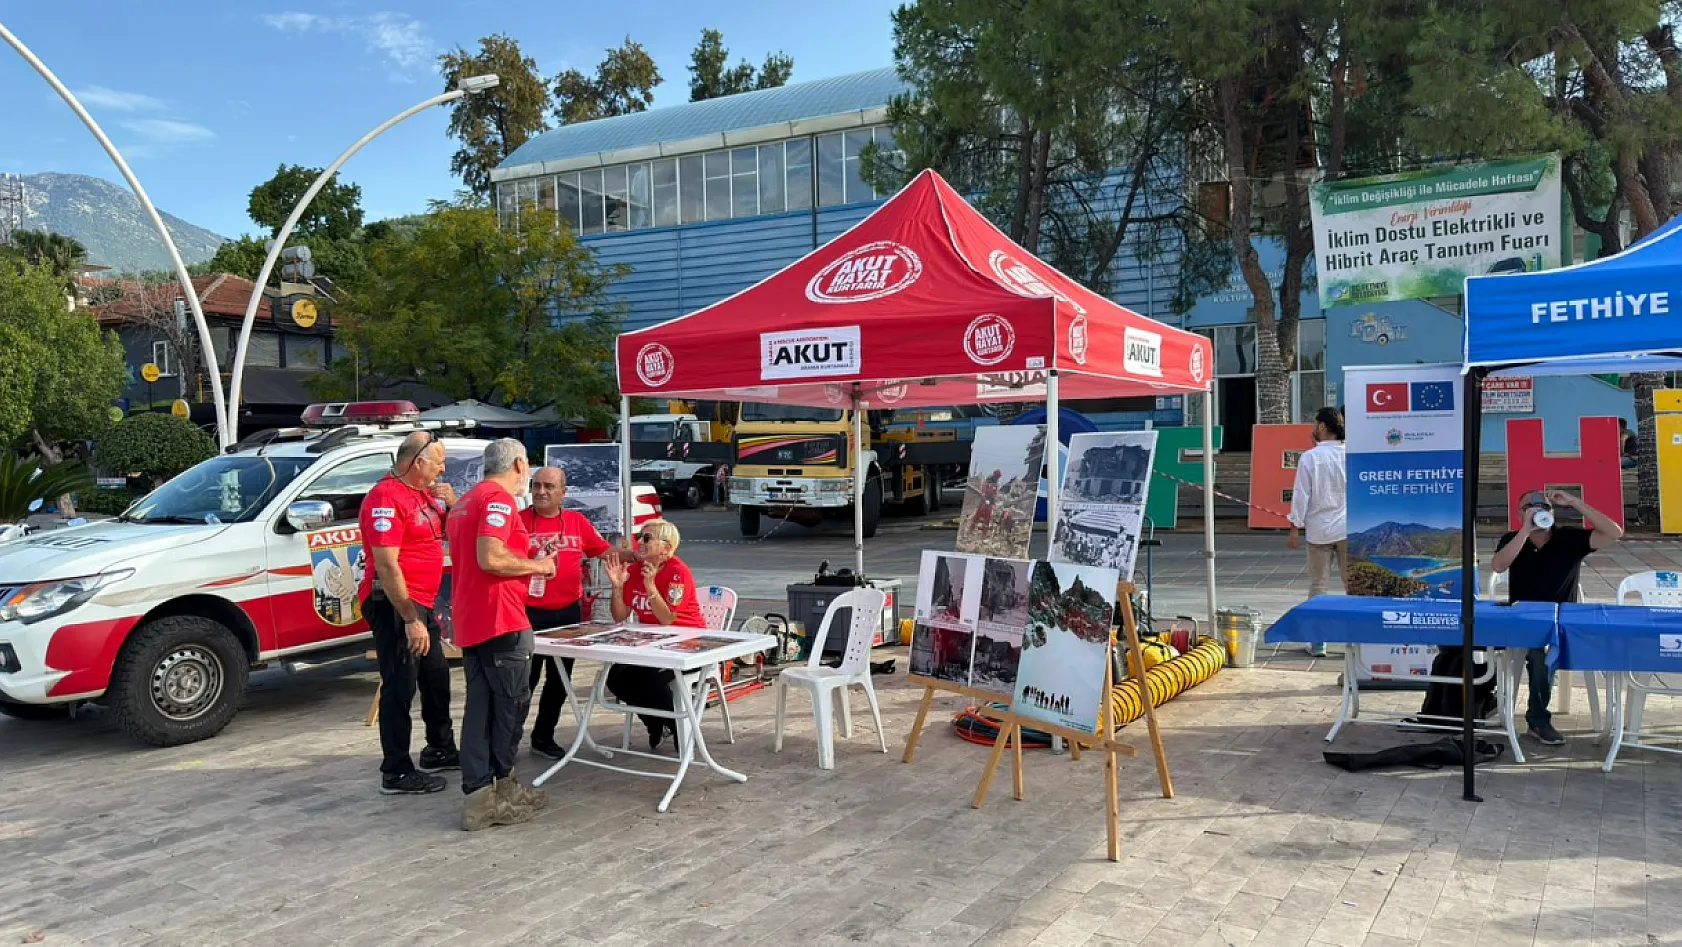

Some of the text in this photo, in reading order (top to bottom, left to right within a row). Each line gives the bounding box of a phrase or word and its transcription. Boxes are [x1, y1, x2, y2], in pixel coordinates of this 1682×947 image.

[1362, 186, 1417, 204] Değişikliği
[1419, 184, 1433, 195] ile
[1435, 179, 1489, 193] Mücadele
[1328, 211, 1545, 250] İklim Dostu Elektrikli ve
[1325, 234, 1550, 271] Hibrit Araç Tanıtım Fuarı
[839, 254, 899, 273] AKUT
[832, 269, 893, 286] HAYAT
[1530, 290, 1669, 324] FETHİYE
[974, 323, 1002, 339] AKUT
[975, 336, 1003, 350] HAYAT
[774, 341, 848, 366] AKUT
[1129, 342, 1157, 365] AKUT
[1359, 466, 1465, 482] GREEN FETHİYE
[1369, 481, 1455, 495] SAFE FETHİYE
[1412, 616, 1459, 625] BELEDİYESİ
